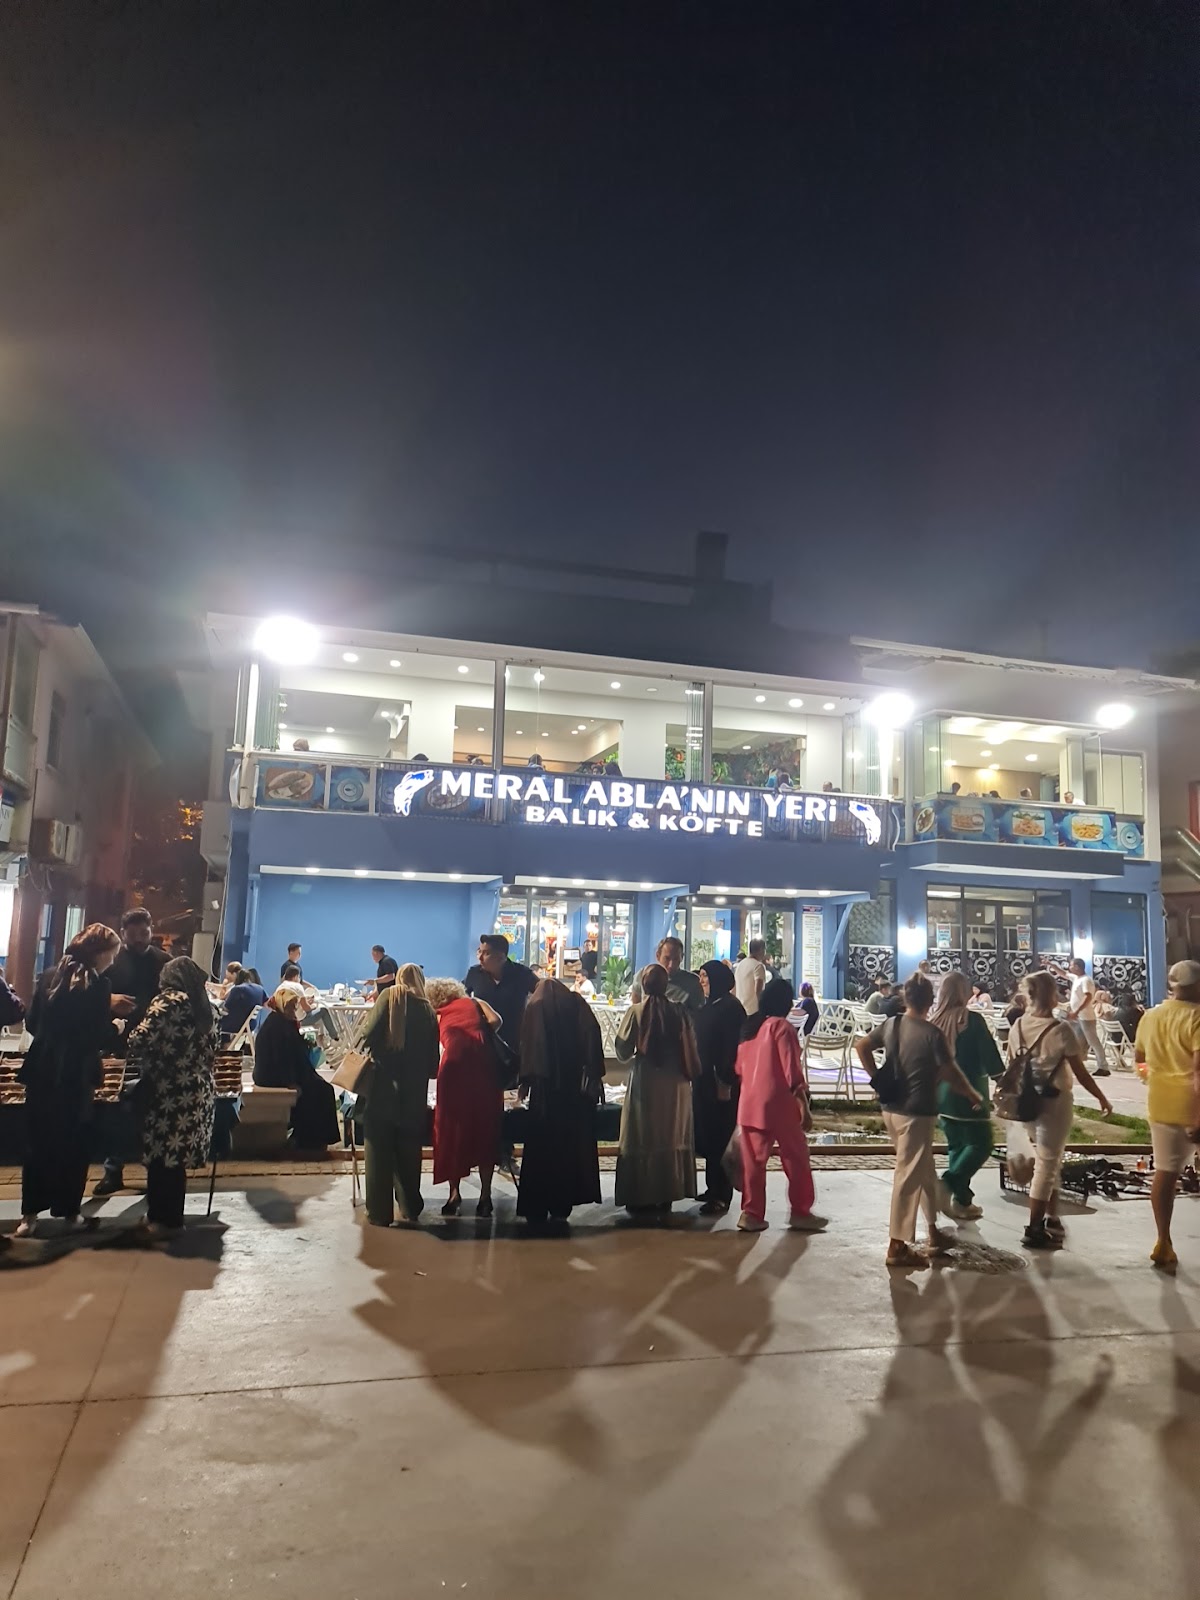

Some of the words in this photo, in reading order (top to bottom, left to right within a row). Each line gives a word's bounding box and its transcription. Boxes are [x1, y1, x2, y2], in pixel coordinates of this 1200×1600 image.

[441, 770, 573, 804] MERAL
[583, 781, 750, 816] ABLA'NIN
[627, 812, 650, 829] &
[659, 812, 763, 837] KÖFTE
